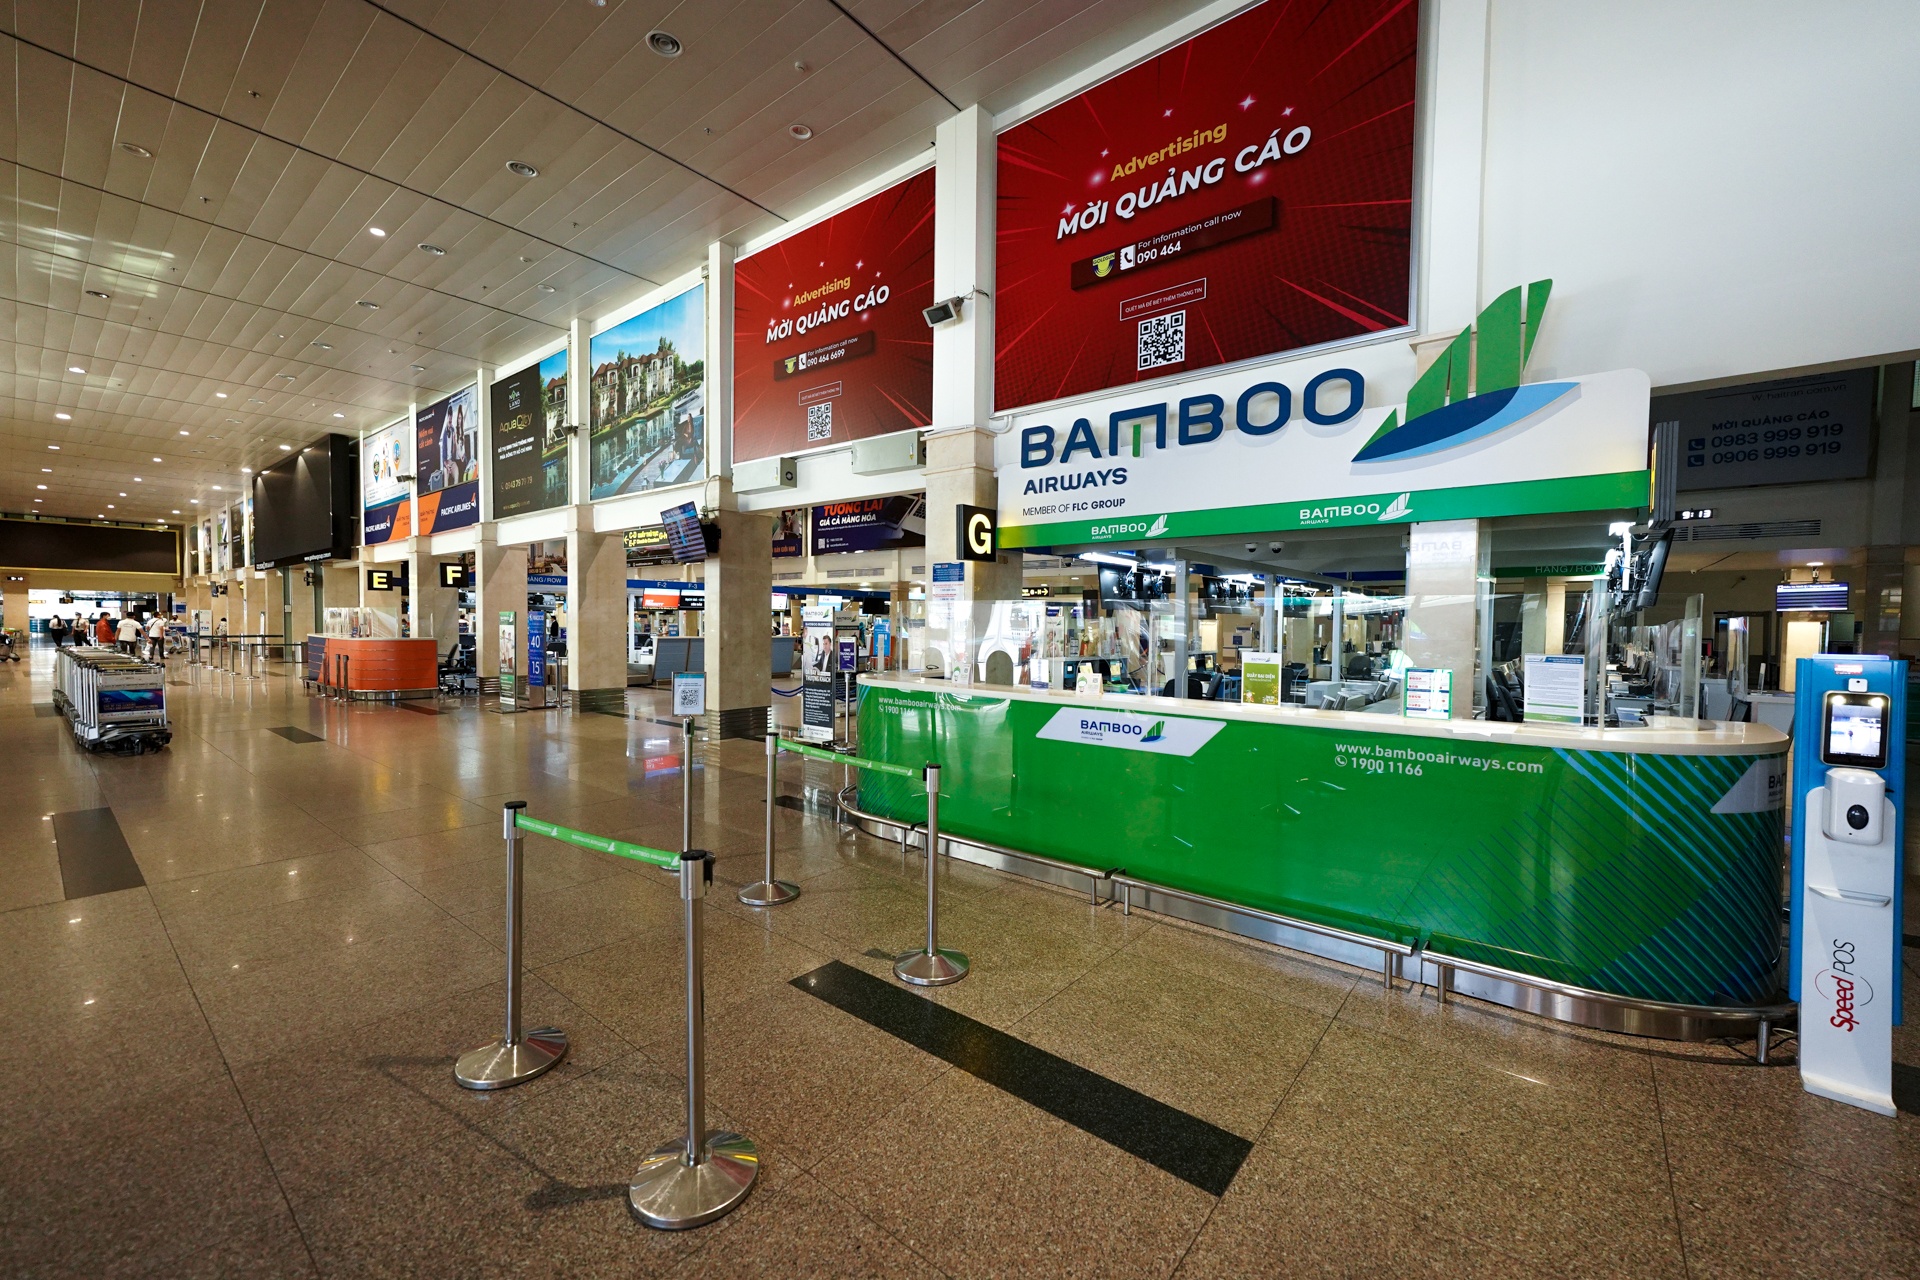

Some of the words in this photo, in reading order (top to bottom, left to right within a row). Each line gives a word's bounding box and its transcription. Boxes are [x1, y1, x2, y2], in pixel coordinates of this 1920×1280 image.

[1110, 122, 1228, 181] Advertising
[1056, 199, 1108, 240] MỜI
[1115, 157, 1226, 219] QUẢNG
[1234, 125, 1312, 173] CÁO
[1138, 240, 1151, 250] For
[1153, 224, 1202, 245] information
[1204, 215, 1220, 228] call
[1222, 210, 1242, 224] now
[1093, 253, 1115, 266] GOLDSUN
[1137, 250, 1157, 264] 090
[1160, 241, 1182, 258] 464
[793, 276, 850, 307] Advertising
[766, 319, 792, 344] MỜI
[796, 300, 850, 334] QUẢNG
[853, 285, 890, 312] CÁO
[807, 358, 817, 367] 090
[818, 354, 829, 363] 464
[830, 349, 845, 360] 6699
[815, 344, 839, 355] information
[1020, 368, 1365, 468] BAMBOO
[1797, 410, 1830, 422] CÁO
[1711, 432, 1758, 448] 0983
[1764, 428, 1802, 443] 999
[1807, 423, 1844, 439] 919
[1712, 449, 1759, 464] 0906
[1764, 445, 1801, 460] 999
[1806, 441, 1842, 456] 919
[1024, 468, 1128, 495] AIRWAYS
[441, 506, 454, 516] PACIFIC
[454, 502, 471, 513] AIRLINES
[1022, 504, 1056, 516] MEMBER
[1058, 504, 1070, 513] OF
[1072, 502, 1088, 512] FLC
[1091, 498, 1126, 509] GROUP
[1300, 503, 1380, 520] BAMBOO
[819, 516, 830, 527] GIÁ
[831, 515, 840, 526] CẢ
[842, 514, 861, 524] HÀNG
[862, 513, 877, 522] HÓA
[1092, 522, 1147, 535] BAMBOO
[968, 514, 991, 554] G
[373, 572, 388, 589] E
[446, 566, 462, 585] F
[531, 635, 540, 648] 40
[532, 661, 540, 674] 15
[885, 705, 898, 714] 1900
[900, 708, 915, 716] 1166
[1081, 720, 1142, 735] BAMBOO
[1335, 742, 1543, 774] www.bambooairways.com
[1351, 757, 1384, 771] 1900
[1388, 761, 1423, 776] 1166
[1832, 939, 1854, 975] POS
[1830, 975, 1860, 1032] Speed
